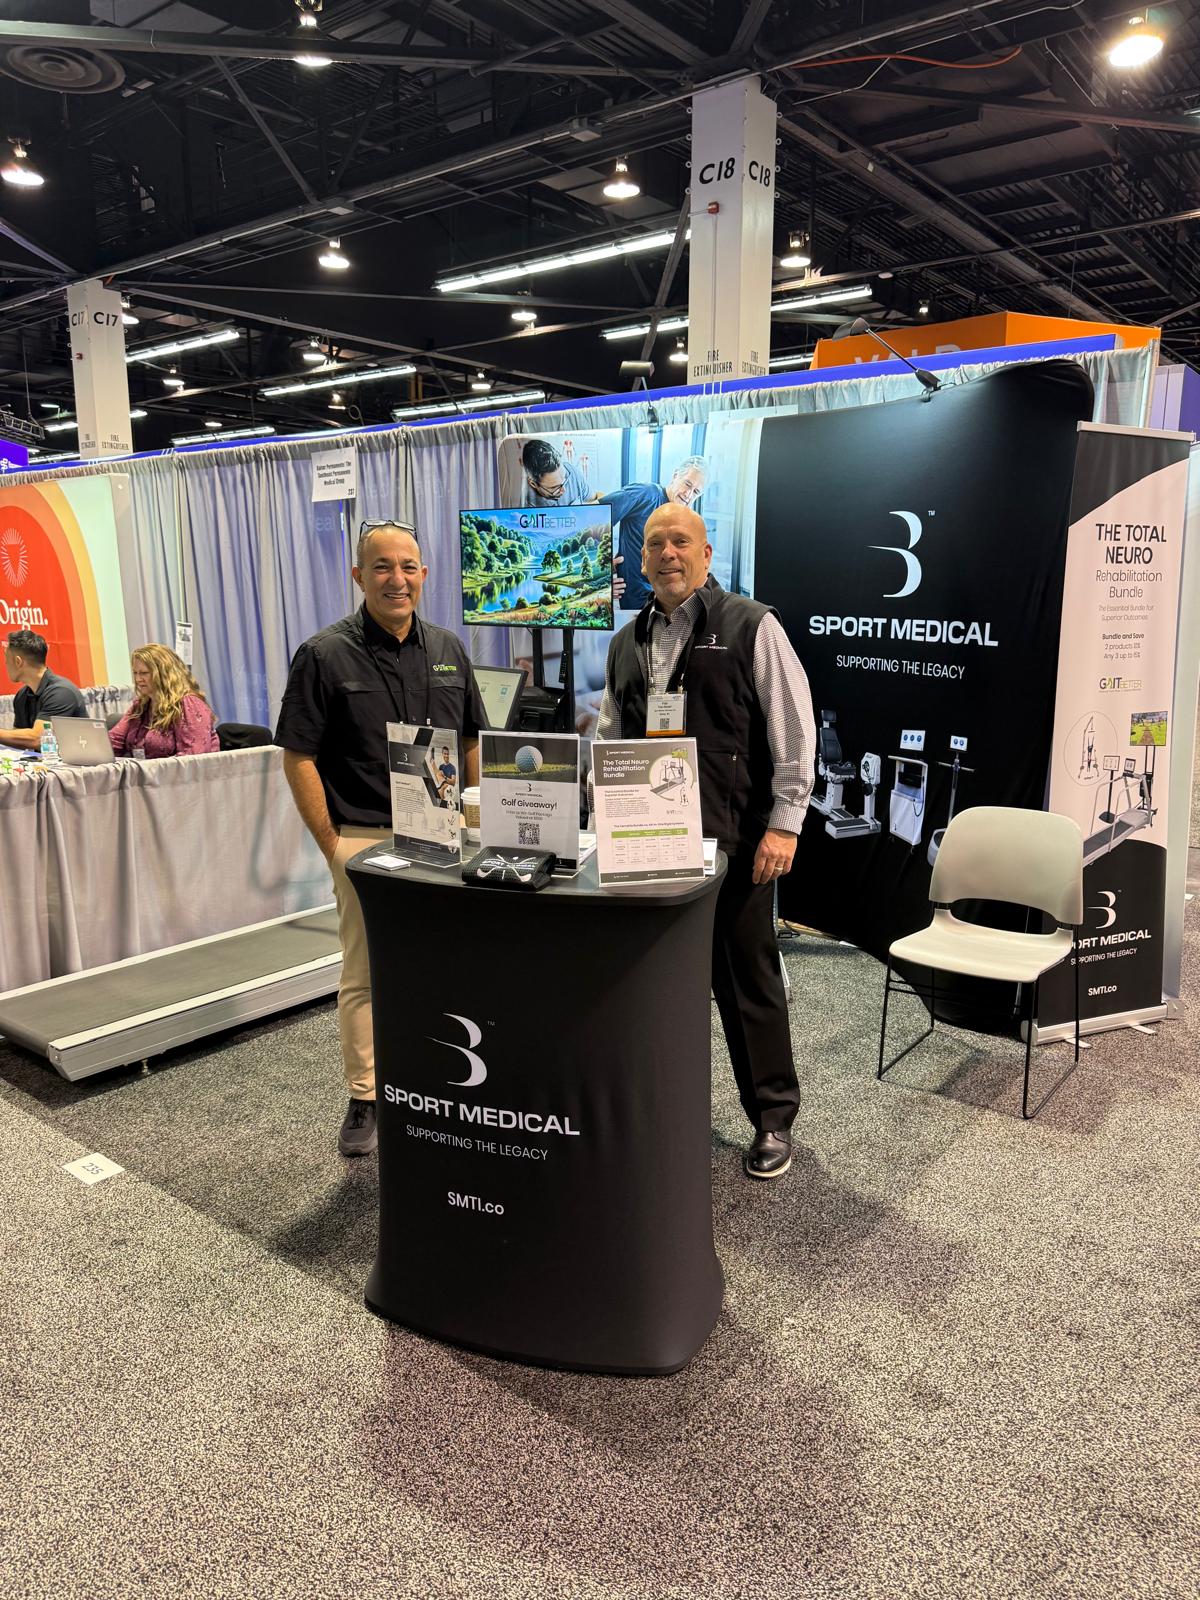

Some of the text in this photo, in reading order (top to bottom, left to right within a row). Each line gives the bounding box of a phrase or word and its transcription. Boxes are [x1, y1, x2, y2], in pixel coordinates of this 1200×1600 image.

[699, 157, 736, 185] C18
[748, 160, 770, 187] C18
[71, 311, 85, 327] C17
[93, 312, 119, 326] C17
[708, 350, 719, 362] FIRE
[1095, 523, 1167, 543] THE TOTAL
[1105, 545, 1153, 565] NEURO
[1095, 569, 1163, 582] Rehabilitation
[1109, 586, 1144, 598] Bundle
[808, 615, 999, 647] SPORT MEDICAL
[1103, 652, 1114, 660] Any
[1108, 643, 1133, 651] products
[836, 654, 965, 680] SUPPORTING THE LEGACY
[501, 798, 558, 811] Golf Giveaway!
[1071, 929, 1152, 950] ORT MEDICAL
[1106, 950, 1116, 959] THE
[1116, 947, 1138, 958] LEGACY
[1087, 985, 1117, 996] SMTI.co
[384, 1084, 581, 1136] SPORT MEDICAL
[406, 1124, 549, 1161] SUPPORTING THE LEGACY
[447, 1191, 505, 1215] SMTI.co
